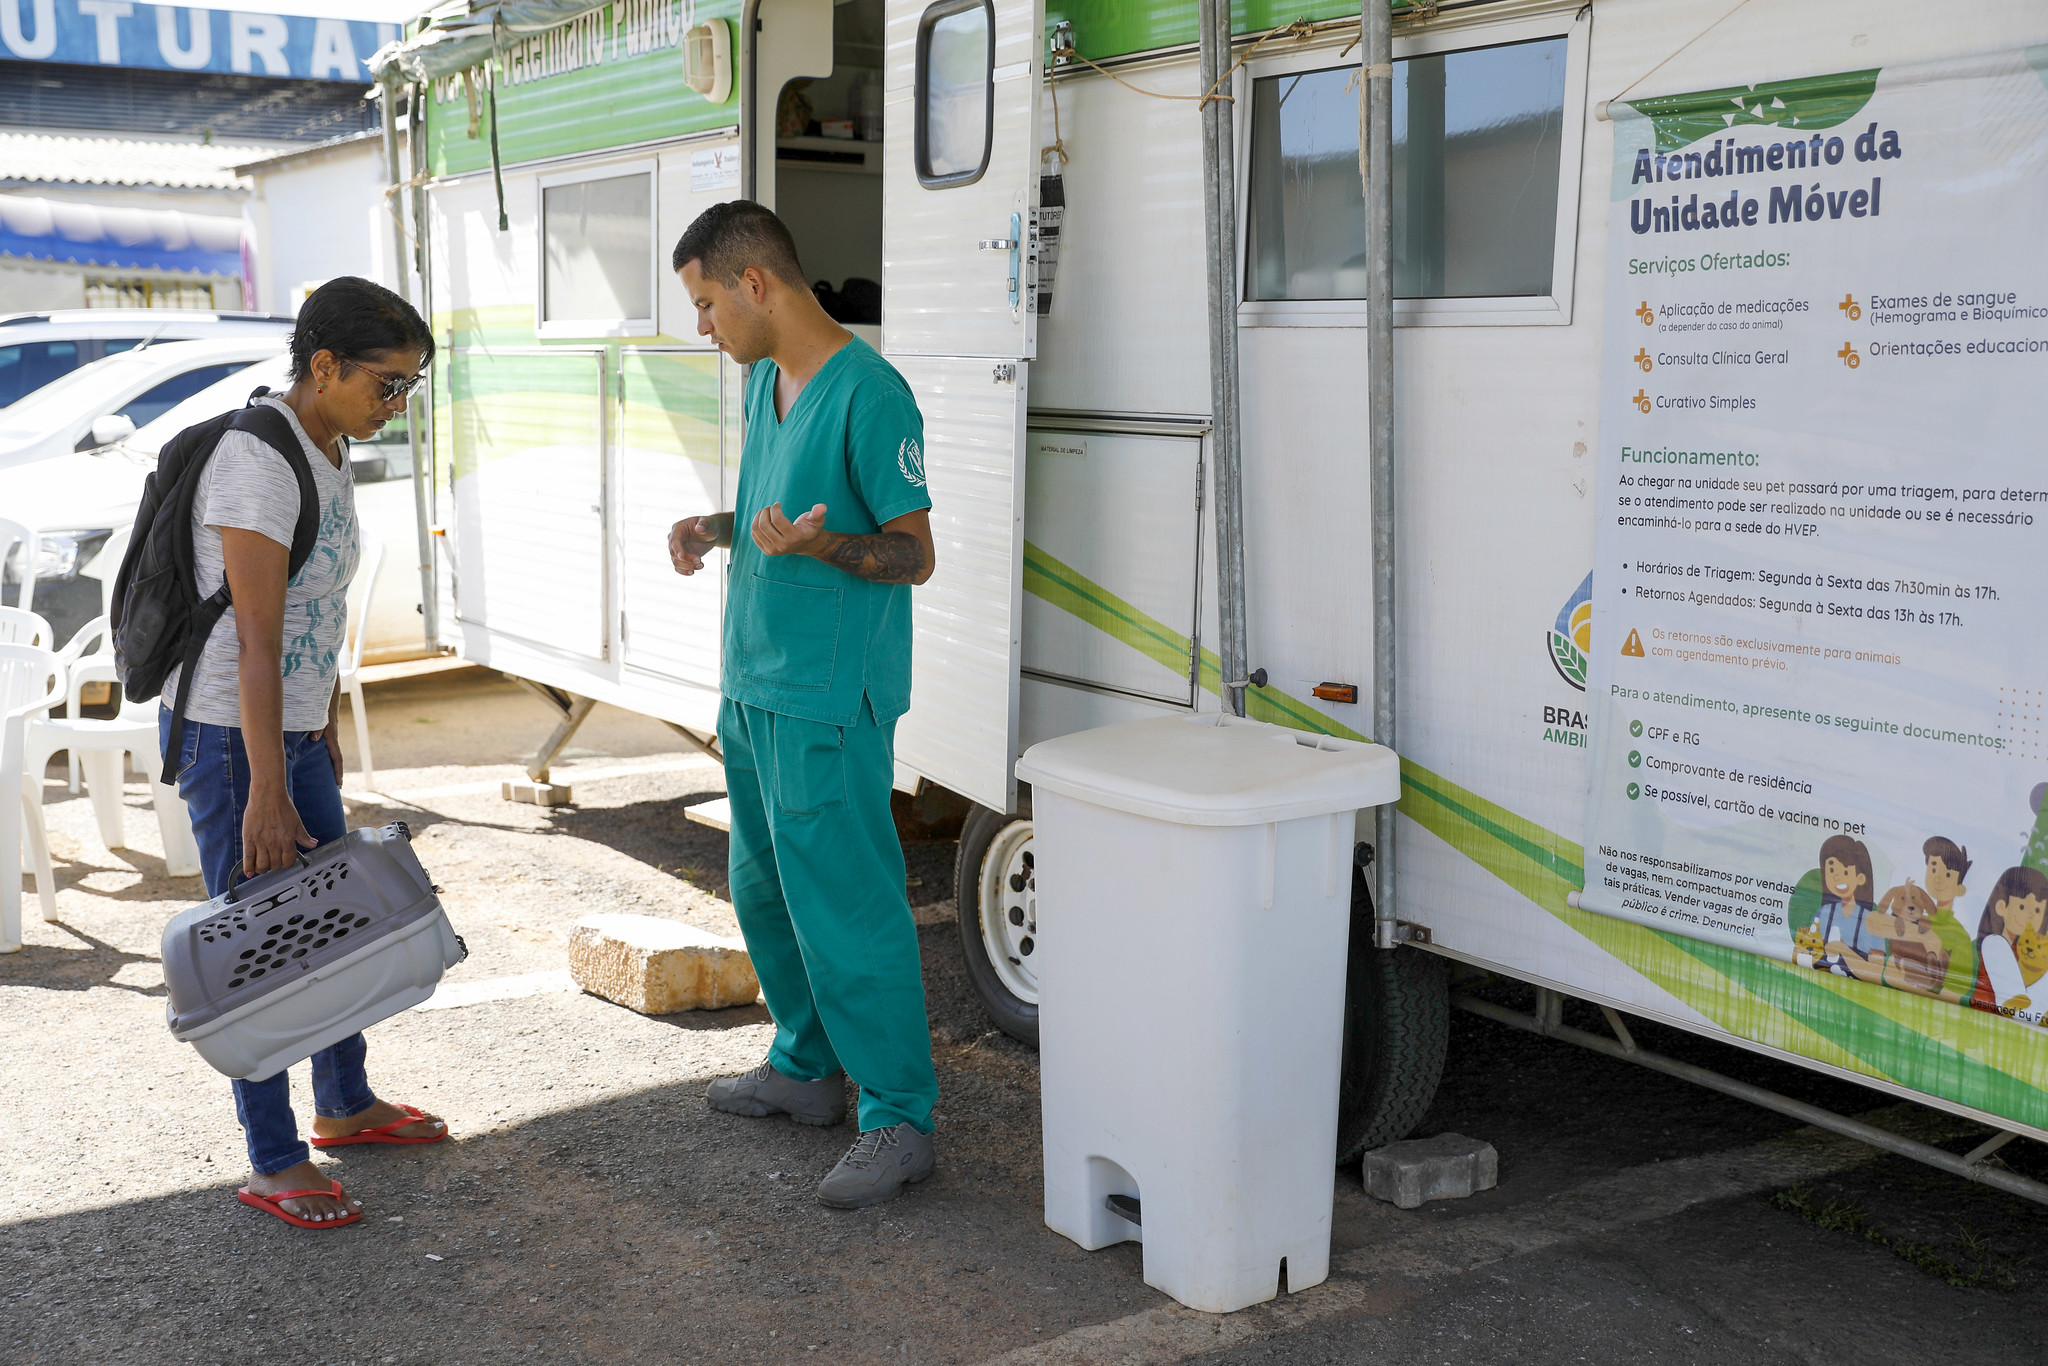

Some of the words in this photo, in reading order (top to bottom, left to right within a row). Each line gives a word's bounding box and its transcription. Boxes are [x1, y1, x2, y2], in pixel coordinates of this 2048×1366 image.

[0, 0, 396, 80] UTURA
[1631, 133, 1844, 185] Atendimento
[1854, 122, 1902, 162] da
[1630, 190, 1759, 235] Unidade
[1768, 177, 1881, 225] Móvel
[1628, 256, 1695, 277] Serviços
[1700, 250, 1790, 271] Ofertados:
[1659, 301, 1714, 318] Aplicação
[1718, 301, 1732, 314] de
[1736, 298, 1809, 314] medicações
[1871, 295, 1928, 309] Exames
[1933, 292, 1952, 306] de
[1957, 292, 2016, 308] sangue
[1658, 324, 1667, 333] (a
[1668, 322, 1704, 333] depender
[1707, 322, 1717, 330] do
[1719, 322, 1737, 330] caso
[1740, 321, 1750, 329] do
[1752, 320, 1783, 330] animal)
[1870, 311, 1956, 326] (Hemograma
[1960, 310, 1968, 320] e
[1658, 352, 1708, 365] Consulta
[1712, 351, 1751, 365] Clínica
[1755, 350, 1789, 364] Geral
[1869, 340, 1961, 357] Orientações
[1656, 396, 1706, 409] Curativo
[1709, 396, 1756, 412] Simples
[1621, 447, 1759, 466] Funcionamento:
[1619, 475, 1634, 486] Ao
[1638, 475, 1675, 490] chegar
[1678, 478, 1692, 489] na
[1695, 478, 1740, 490] unidade
[1743, 481, 1762, 491] seu
[1766, 481, 1785, 494] pet
[1788, 481, 1838, 495] passará
[1842, 483, 1864, 498] por
[1868, 485, 1897, 497] uma
[1901, 485, 1958, 500] triagem,
[1962, 488, 1996, 502] para
[1618, 496, 1631, 506] se
[1635, 498, 1641, 506] o
[1644, 496, 1714, 510] atendimento
[1717, 500, 1746, 513] pode
[1749, 502, 1767, 513] ser
[1771, 502, 1826, 516] realizado
[1830, 506, 1845, 517] na
[1849, 506, 1901, 519] unidade
[1905, 509, 1921, 520] ou
[1926, 510, 1941, 521] se
[1945, 509, 1953, 521] é
[1958, 511, 2033, 525] necessário
[1618, 515, 1691, 529] encaminhá-lo
[1694, 520, 1720, 532] para
[1725, 523, 1732, 531] a
[1735, 522, 1761, 534] sede
[1765, 522, 1781, 534] do
[1785, 524, 1819, 537] HVEP.
[1636, 561, 1683, 576] Horários
[1686, 565, 1700, 576] de
[1704, 566, 1755, 582] Triagem:
[1758, 570, 1812, 586] Segunda
[1816, 574, 1823, 587] à
[1827, 575, 1862, 590] Sexta
[1867, 578, 1890, 592] das
[1894, 580, 1950, 596] 7h30min
[1955, 585, 1970, 598] às
[1975, 586, 2000, 600] 17h.
[1635, 586, 1685, 601] Retornos
[1688, 592, 1756, 607] Agendados:
[1759, 597, 1812, 613] Segunda
[1816, 602, 1824, 614] à
[1828, 603, 1862, 617] Sexta
[1867, 606, 1890, 619] das
[1894, 609, 1915, 622] 13h
[1919, 611, 1934, 624] às
[1938, 613, 1963, 626] 17h.
[1652, 628, 1665, 639] Os
[1668, 630, 1711, 645] retornos
[1714, 635, 1733, 646] são
[1736, 638, 1820, 656] exclusivamente
[1824, 648, 1851, 660] para
[1855, 651, 1901, 665] animais
[1652, 645, 1673, 656] com
[1676, 647, 1749, 666] agendamento
[1752, 655, 1789, 671] prévio.
[1544, 706, 1588, 729] BRA
[1611, 685, 1639, 699] Para
[1642, 690, 1650, 700] o
[1653, 694, 1739, 714] atendimento,
[1742, 703, 1811, 723] apresente
[1815, 713, 1830, 725] os
[1834, 716, 1899, 734] seguinte
[1903, 723, 2006, 749] documentos:
[1543, 728, 1587, 748] AMBI
[1648, 727, 1669, 740] CPF
[1673, 732, 1679, 742] e
[1683, 732, 1700, 745] RG
[1646, 756, 1725, 780] Comprovante
[1729, 769, 1744, 783] de
[1748, 773, 1812, 794] residência
[1644, 784, 1658, 797] Se
[1661, 789, 1710, 809] possível,
[1714, 798, 1754, 815] cartão
[1758, 805, 1774, 818] de
[1778, 810, 1819, 826] vacina
[1823, 818, 1840, 830] no
[1843, 821, 1865, 835] pet
[1599, 845, 1618, 857] Não
[1621, 851, 1637, 861] nos
[1640, 856, 1732, 881] responsabilizamos
[1734, 874, 1753, 885] por
[1756, 878, 1795, 894] vendas
[1606, 862, 1618, 873] de
[1620, 866, 1649, 881] vagas,
[1652, 873, 1673, 885] nem
[1676, 879, 1757, 903] compactuamos
[1759, 897, 1783, 909] com
[1604, 877, 1621, 888] tais
[1622, 881, 1662, 898] práticas.
[1664, 890, 1700, 907] Vender
[1702, 900, 1733, 916] vagas
[1735, 907, 1748, 917] de
[1751, 909, 1783, 925] órgão
[1621, 898, 1659, 914] público
[1661, 907, 1667, 916] é
[1669, 911, 1699, 924] crime.
[1702, 916, 1755, 937] Denuncie!
[1970, 996, 2016, 1016] Designed
[2019, 1008, 2031, 1021] by
